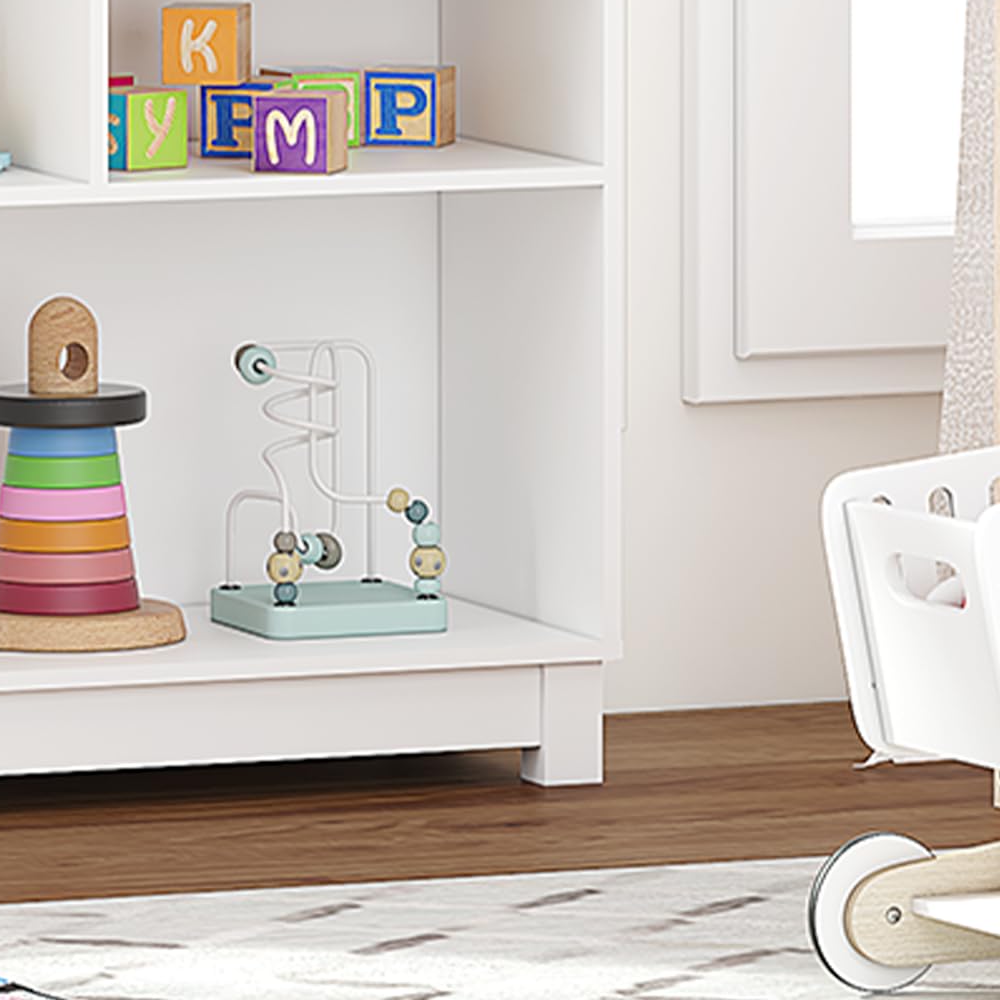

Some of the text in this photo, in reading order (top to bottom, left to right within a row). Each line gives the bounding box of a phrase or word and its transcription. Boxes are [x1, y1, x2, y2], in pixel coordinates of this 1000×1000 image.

[180, 19, 217, 73] K
[373, 83, 428, 135] P
[266, 108, 316, 165] M
